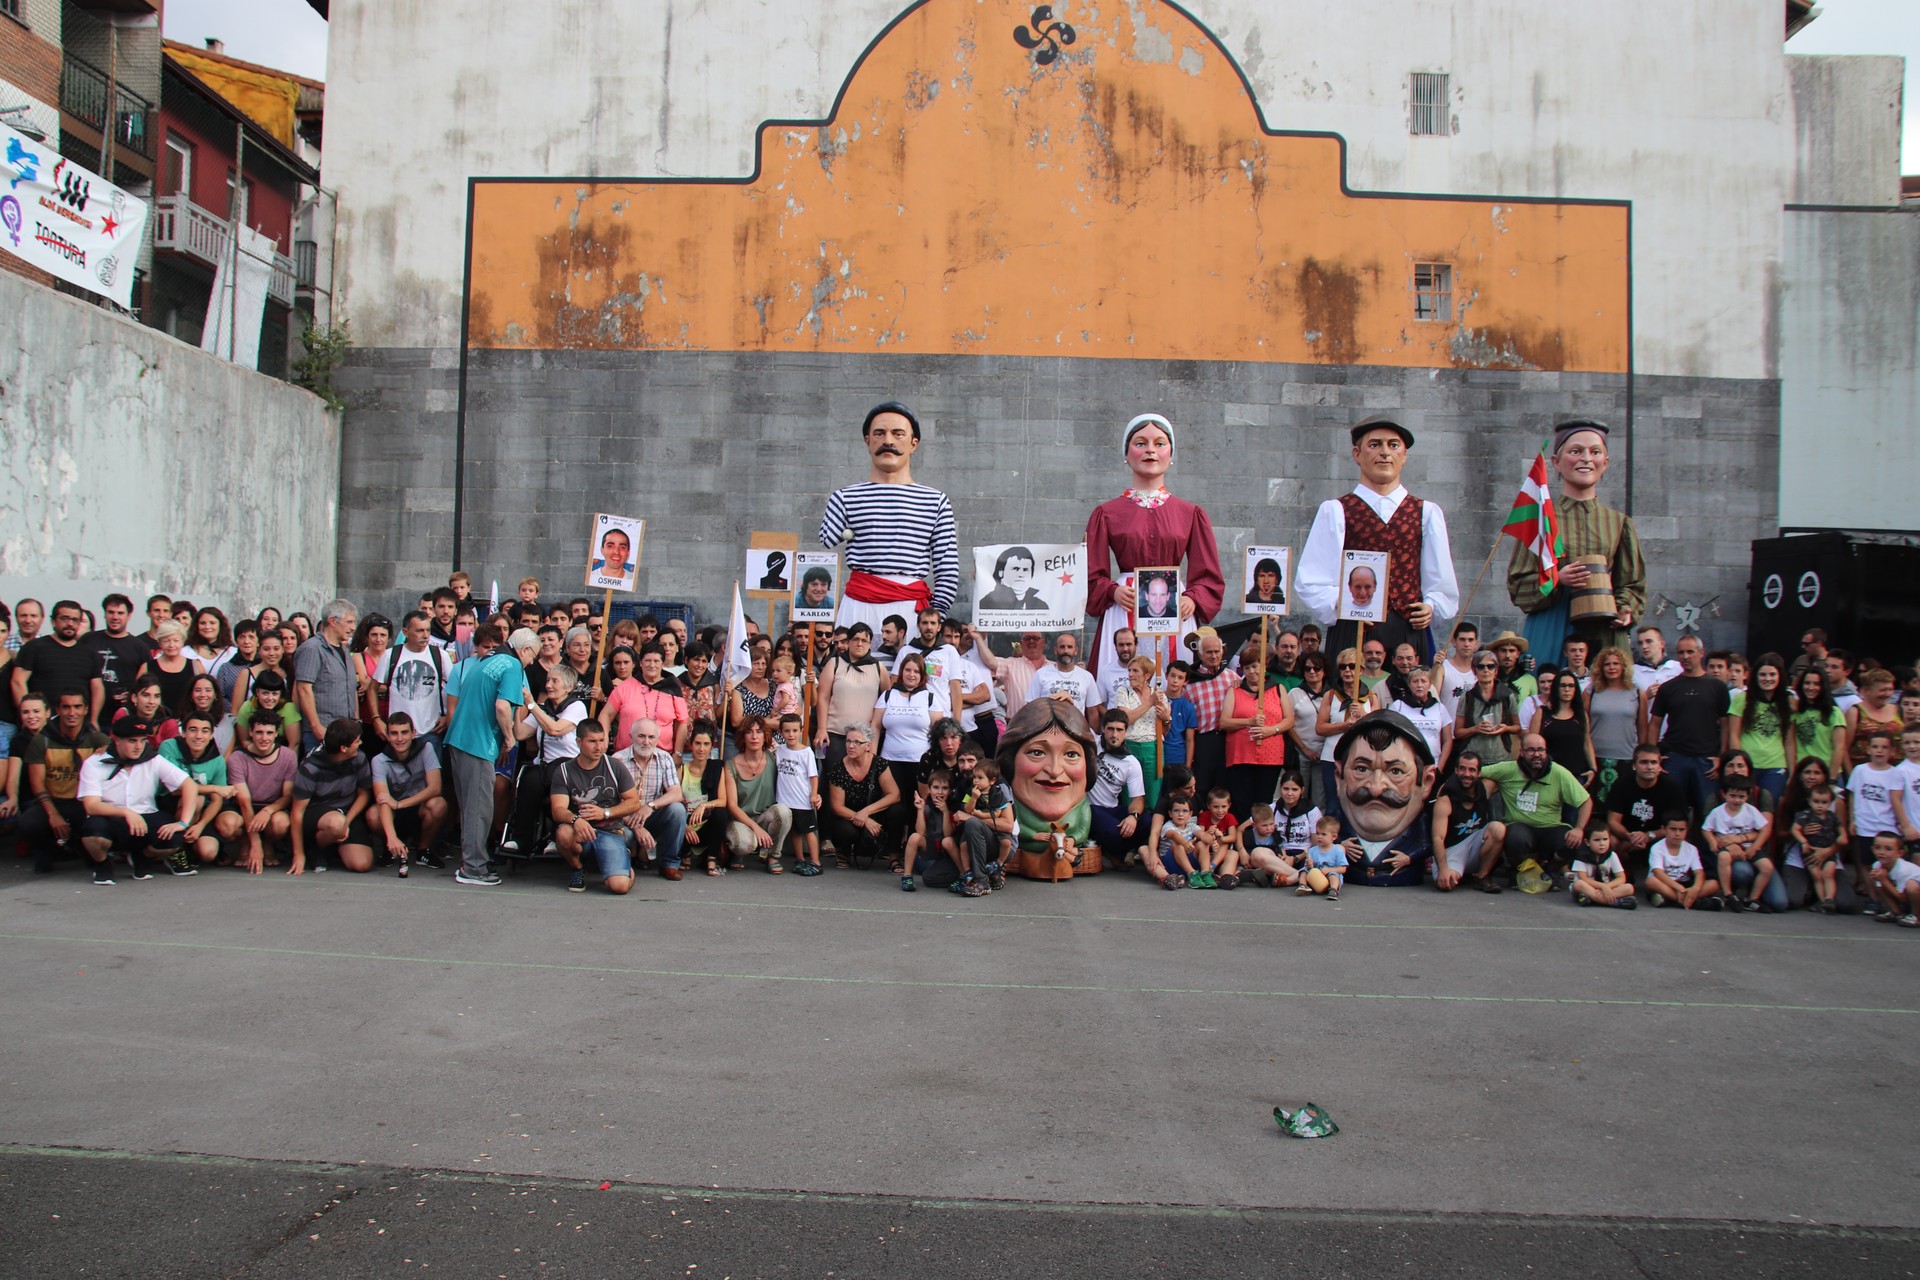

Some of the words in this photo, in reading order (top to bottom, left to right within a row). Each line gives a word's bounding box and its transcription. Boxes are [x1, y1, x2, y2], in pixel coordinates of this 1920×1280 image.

[35, 220, 86, 269] TORTURA
[1044, 553, 1076, 573] REMI
[597, 577, 622, 587] OSKAR
[1350, 610, 1373, 618] EMILIO
[978, 618, 989, 627] Ez
[991, 618, 1027, 630] zaitugu
[1030, 617, 1076, 628] ahaztuko!
